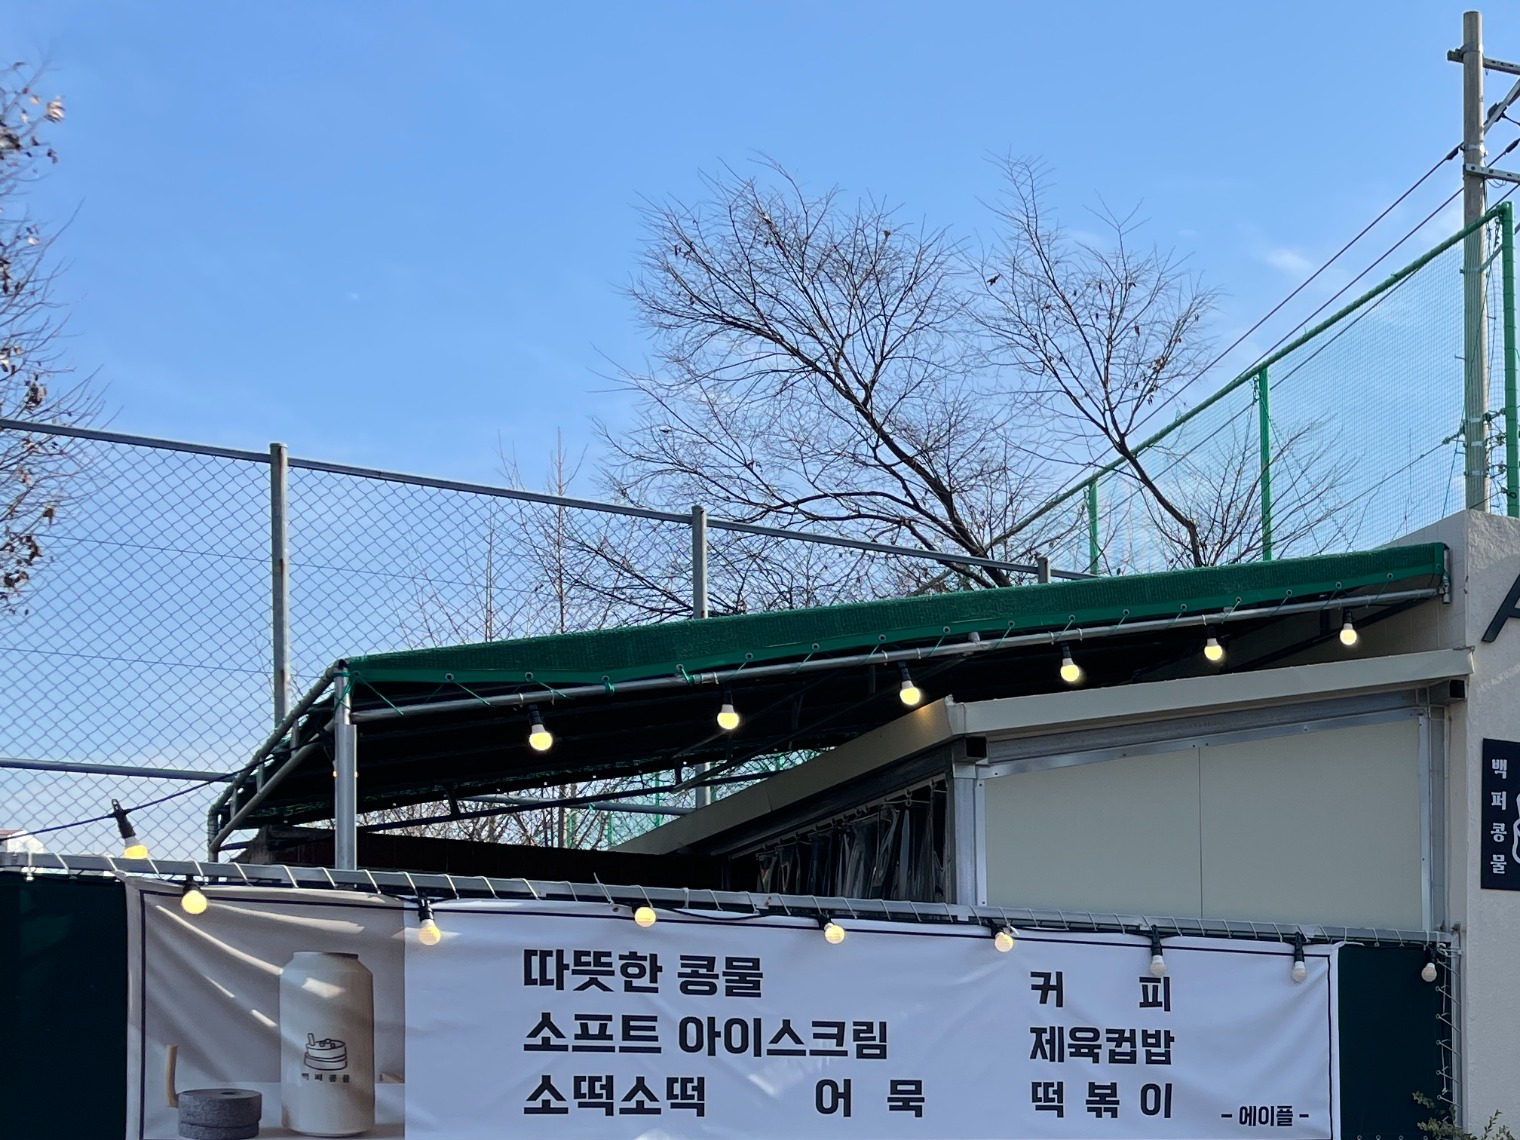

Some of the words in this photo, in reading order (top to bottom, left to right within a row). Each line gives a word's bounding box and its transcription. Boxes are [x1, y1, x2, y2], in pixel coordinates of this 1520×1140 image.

[523, 948, 663, 994] 따뜻한
[677, 954, 764, 998] 콩물
[523, 1011, 662, 1054] 소프트
[678, 1016, 888, 1060] 아이스크림
[1029, 1026, 1175, 1066] 제육컵밥
[523, 1074, 705, 1118] 소떡소떡
[1031, 1081, 1173, 1119] 떡볶이
